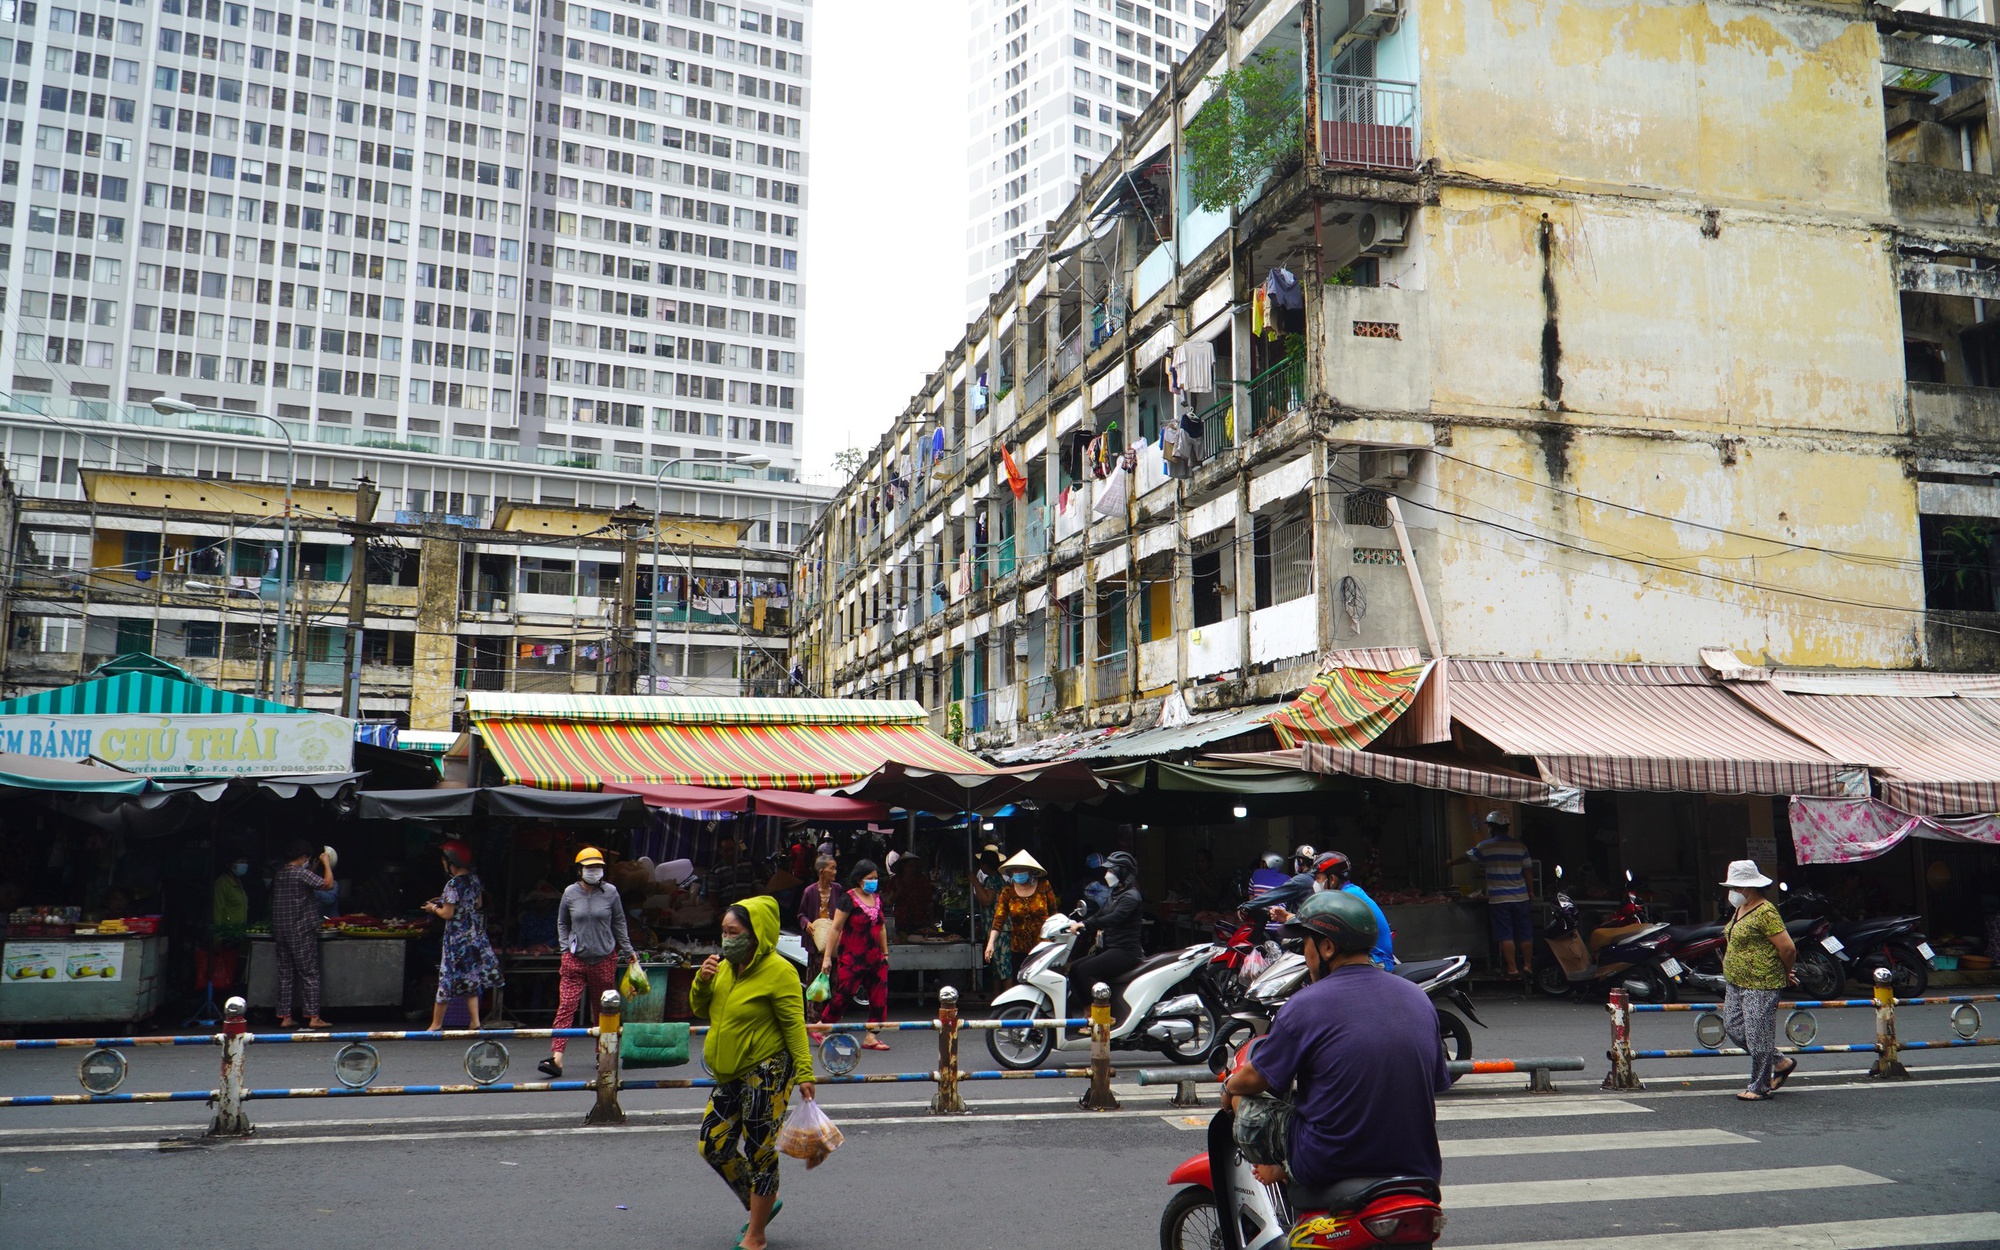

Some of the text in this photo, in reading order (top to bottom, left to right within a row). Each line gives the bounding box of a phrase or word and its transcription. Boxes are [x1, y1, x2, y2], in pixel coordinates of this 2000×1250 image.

[29, 721, 93, 758] BÁNH
[99, 718, 179, 762] CHÚ
[186, 717, 279, 761] THÁI
[1312, 919, 1340, 932] HONDA
[1233, 1186, 1256, 1196] HONDA
